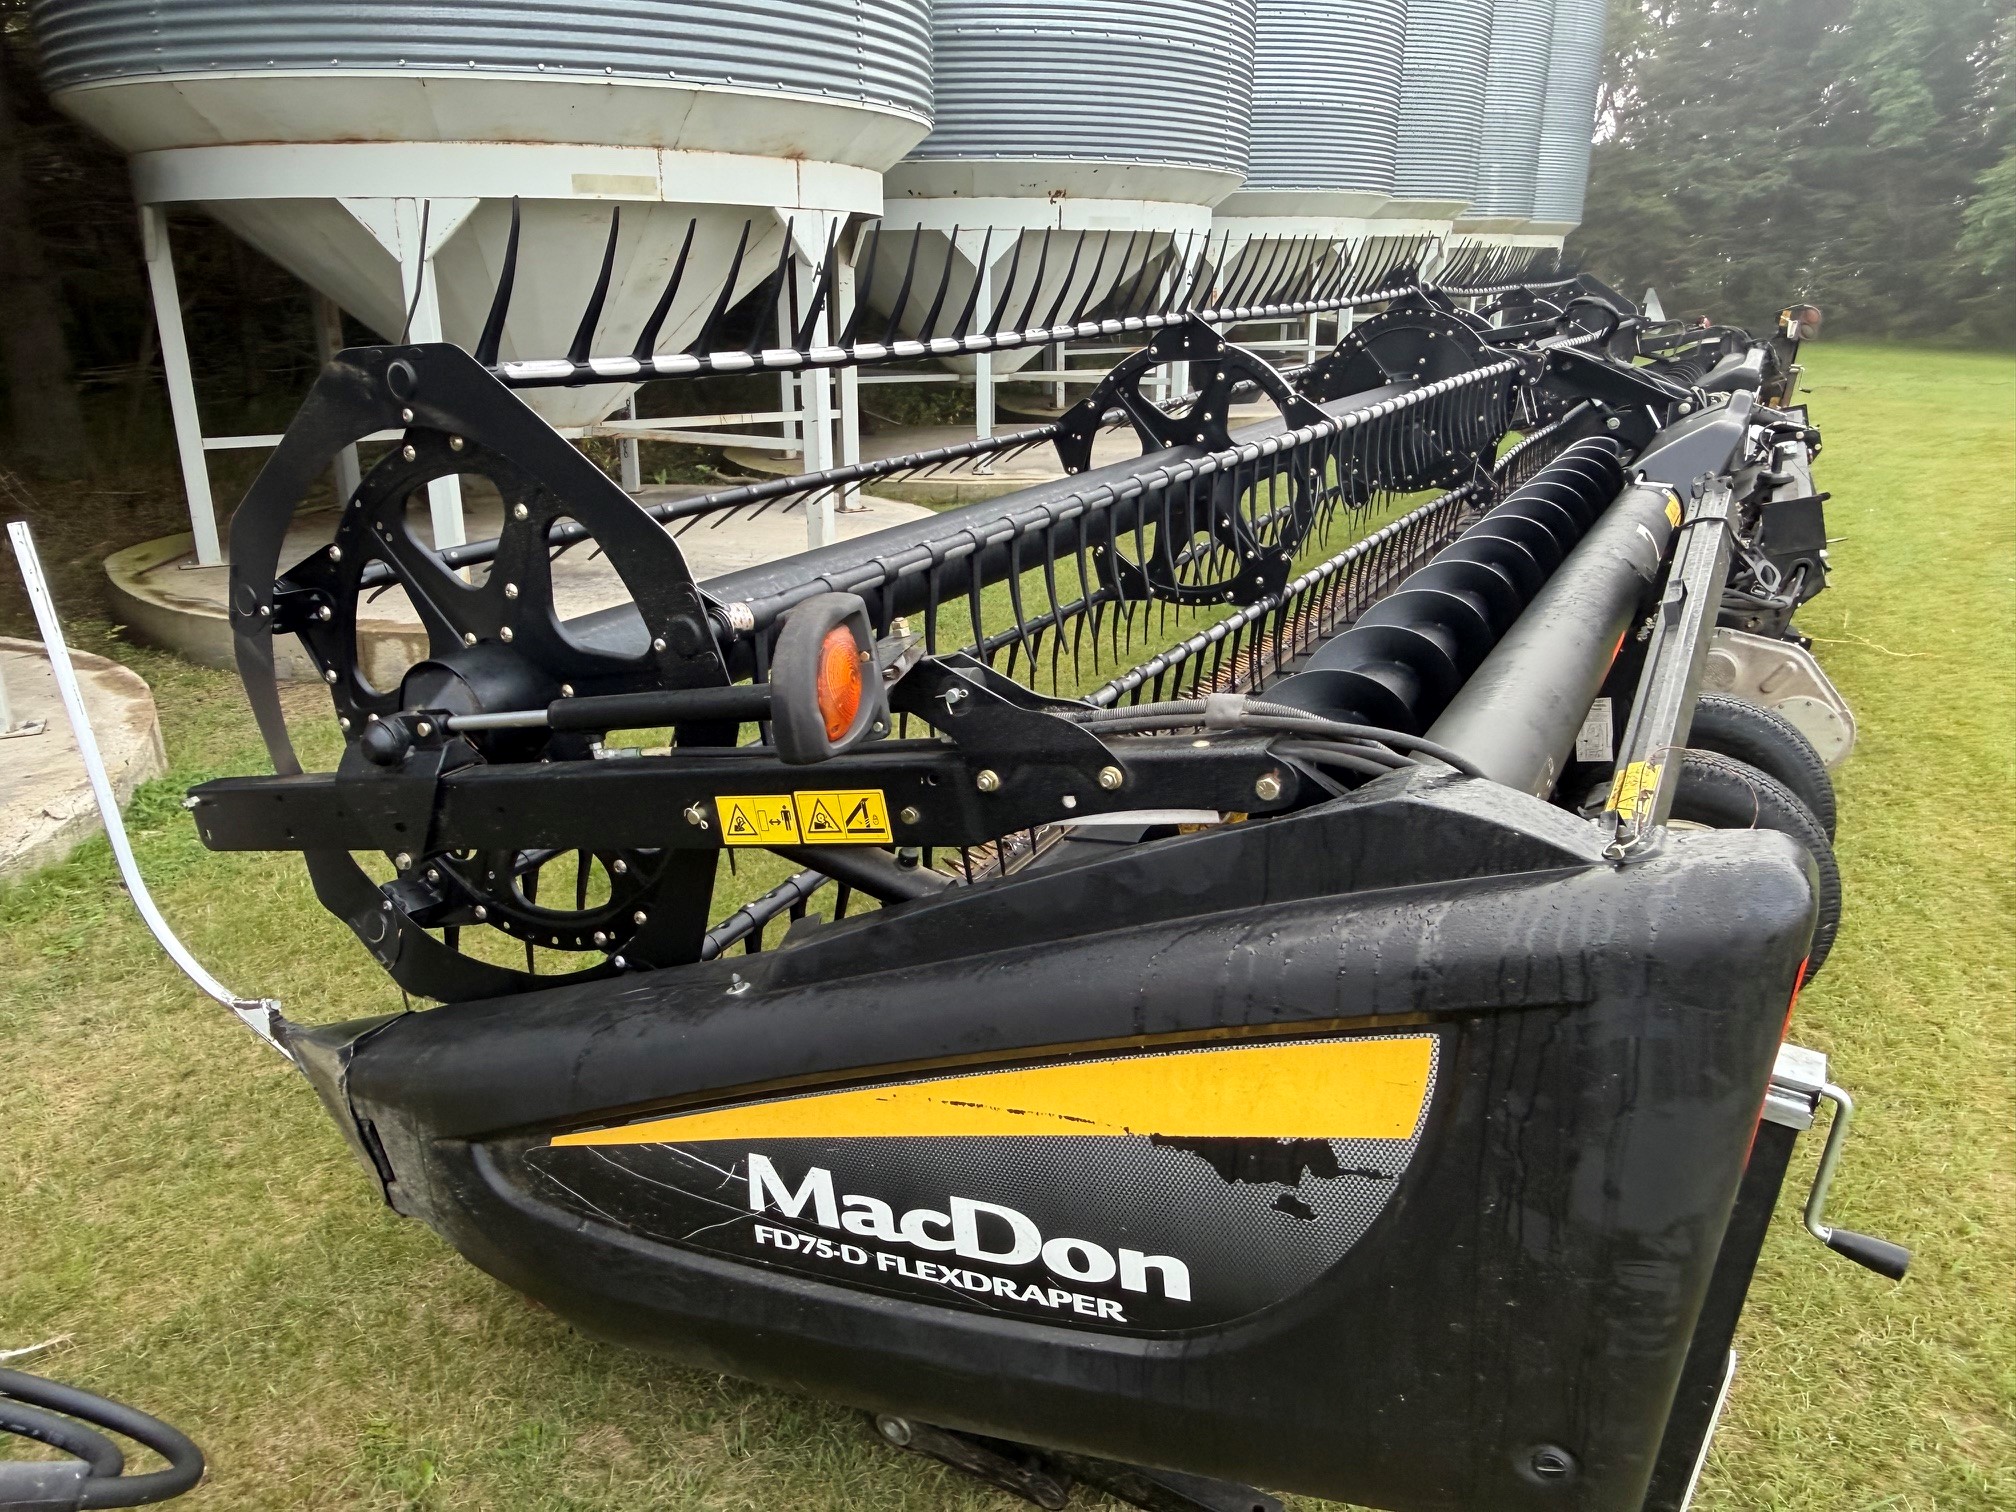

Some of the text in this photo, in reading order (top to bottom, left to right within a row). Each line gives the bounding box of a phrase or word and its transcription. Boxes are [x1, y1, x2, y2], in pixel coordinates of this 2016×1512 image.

[747, 1152, 1191, 1302] MacDon
[754, 1224, 1128, 1323] FD75-D FLEXDRAPER
